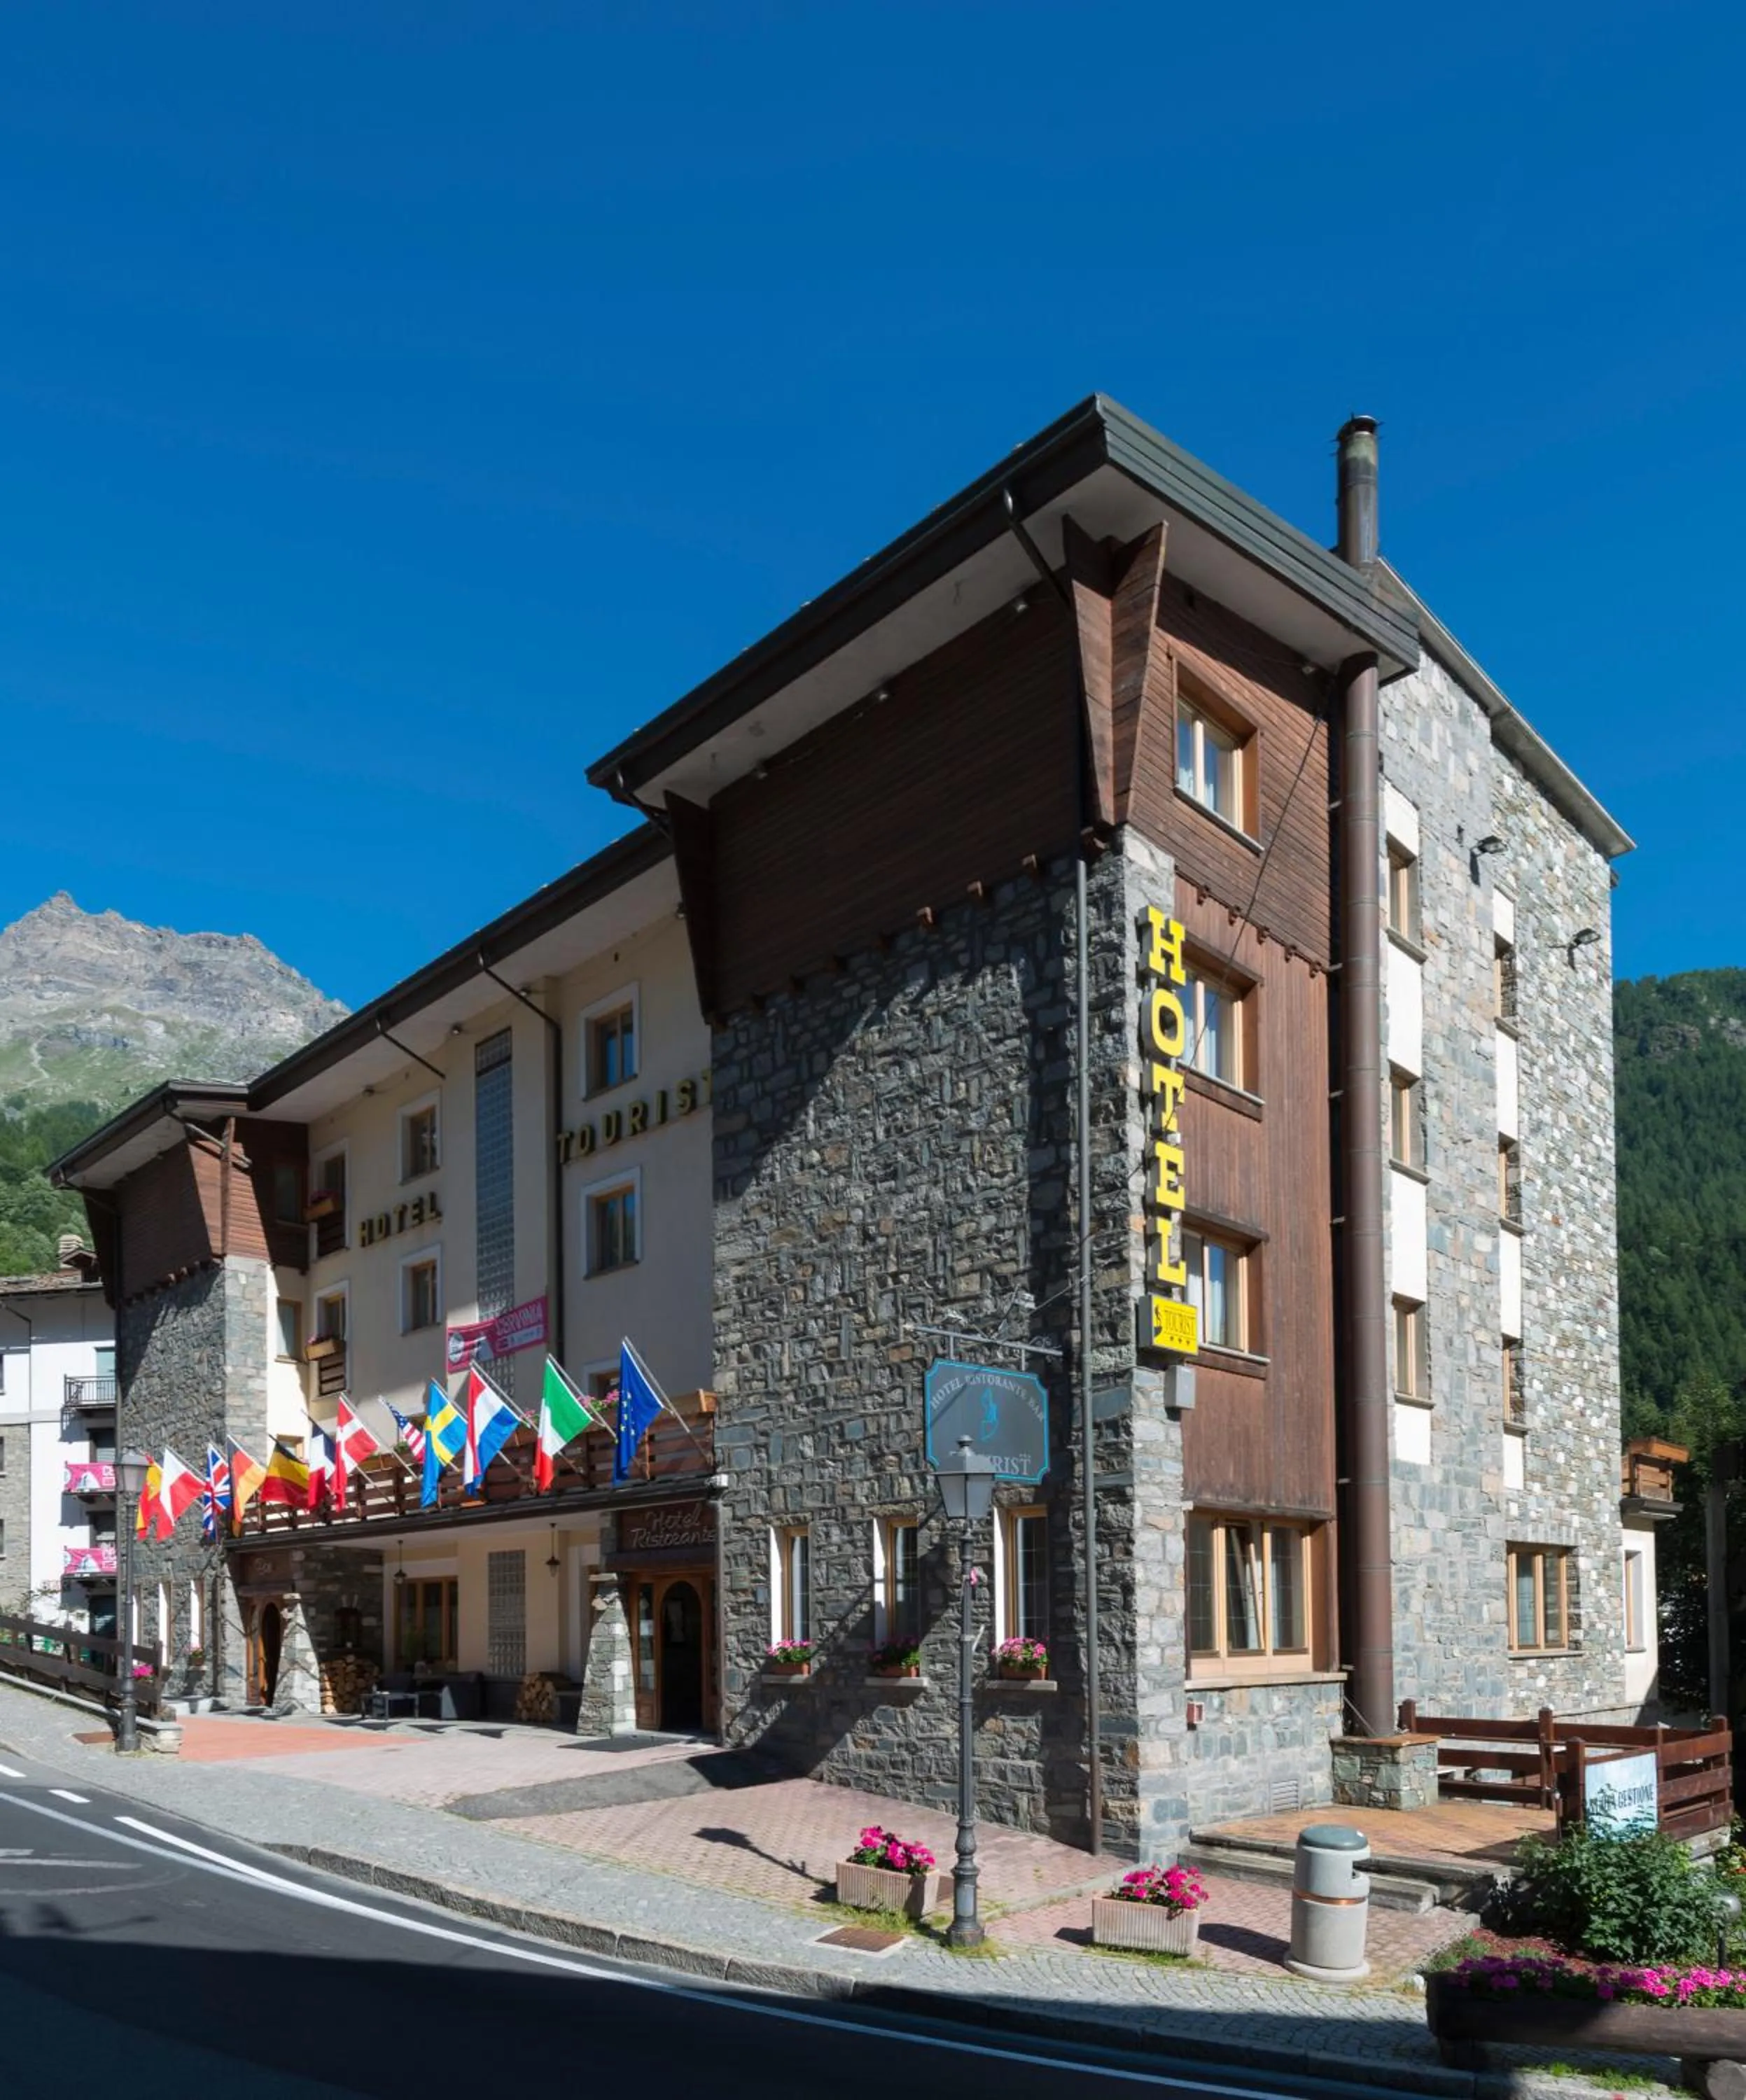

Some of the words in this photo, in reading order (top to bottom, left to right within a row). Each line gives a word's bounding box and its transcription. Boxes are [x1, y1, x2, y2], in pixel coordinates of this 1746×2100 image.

[1147, 905, 1187, 1287] HOTEL
[358, 1191, 442, 1247] HOTEL
[1164, 1309, 1196, 1337] TOURIST
[929, 1378, 964, 1410] HOTEL
[964, 1374, 1028, 1400] RISTORANTE
[1028, 1396, 1044, 1422] BAR
[646, 1502, 701, 1532] Hotel
[630, 1526, 718, 1548] Ristorante
[1618, 1783, 1654, 1809] GESTIONE
